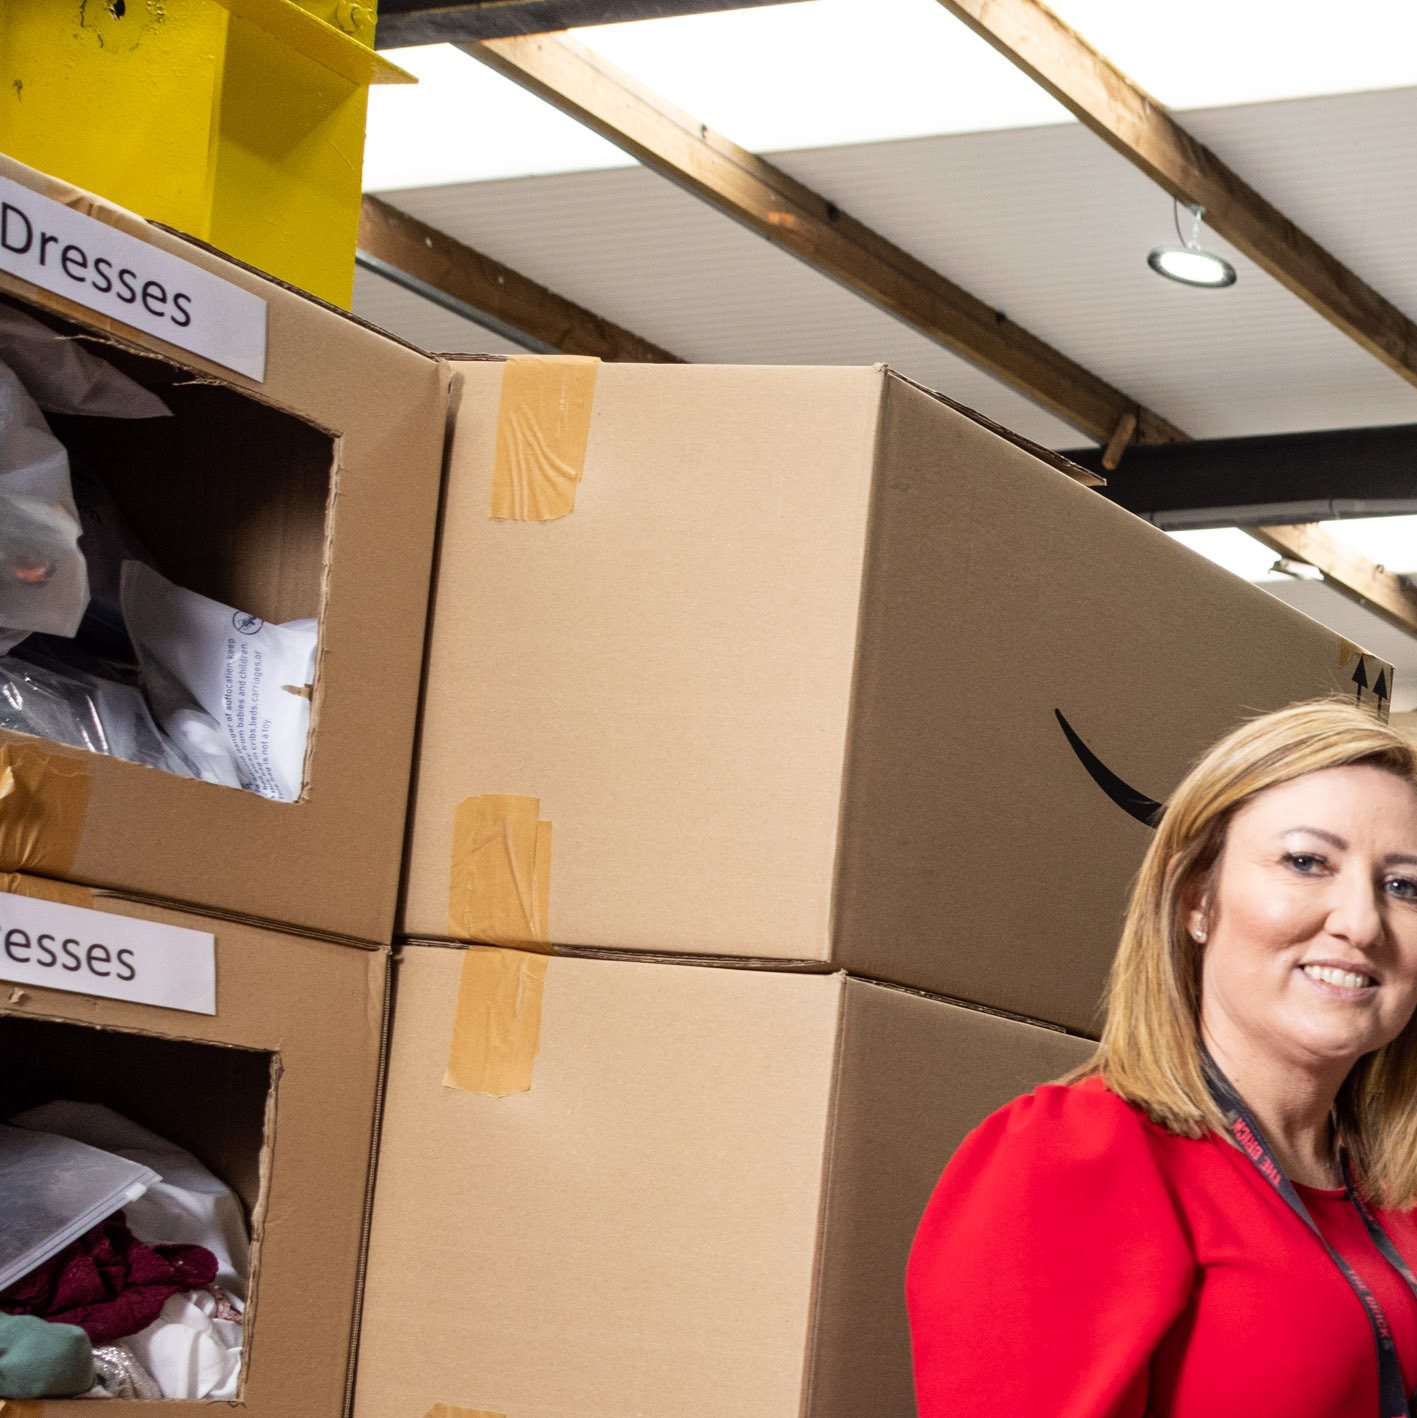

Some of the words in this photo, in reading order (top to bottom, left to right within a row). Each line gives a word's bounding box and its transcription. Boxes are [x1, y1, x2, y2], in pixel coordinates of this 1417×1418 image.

[1, 203, 192, 327] Dresses
[237, 681, 247, 696] and
[225, 713, 233, 722] of
[236, 699, 246, 728] babies
[260, 741, 269, 755] not
[0, 926, 136, 982] esses
[1231, 1116, 1264, 1161] BRICK
[1259, 1155, 1282, 1187] THE
